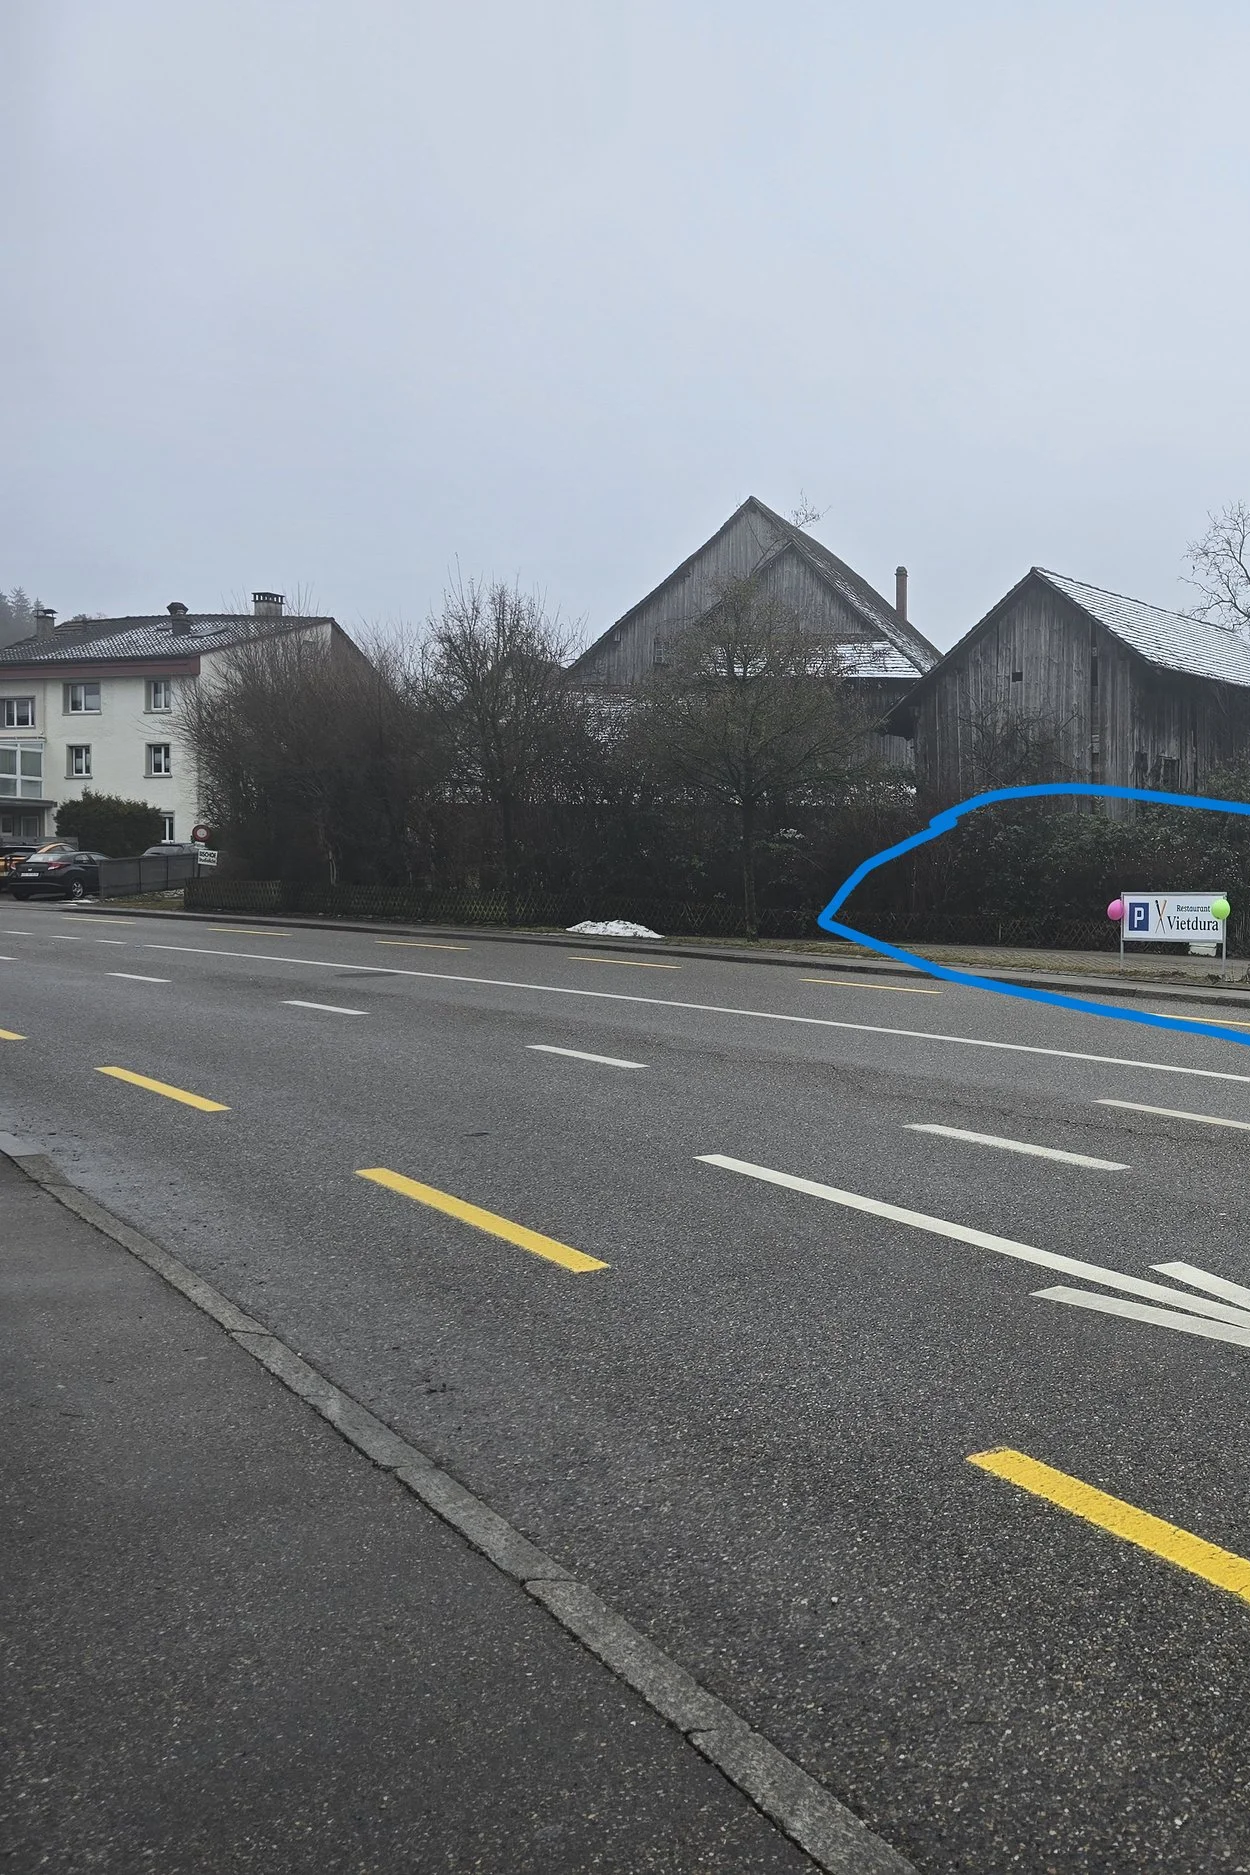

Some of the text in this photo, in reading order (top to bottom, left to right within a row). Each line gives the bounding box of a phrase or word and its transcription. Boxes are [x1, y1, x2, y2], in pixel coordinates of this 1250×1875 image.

[1176, 904, 1211, 912] Restaurant
[1134, 907, 1144, 928] P
[1167, 915, 1219, 931] Vietdura
